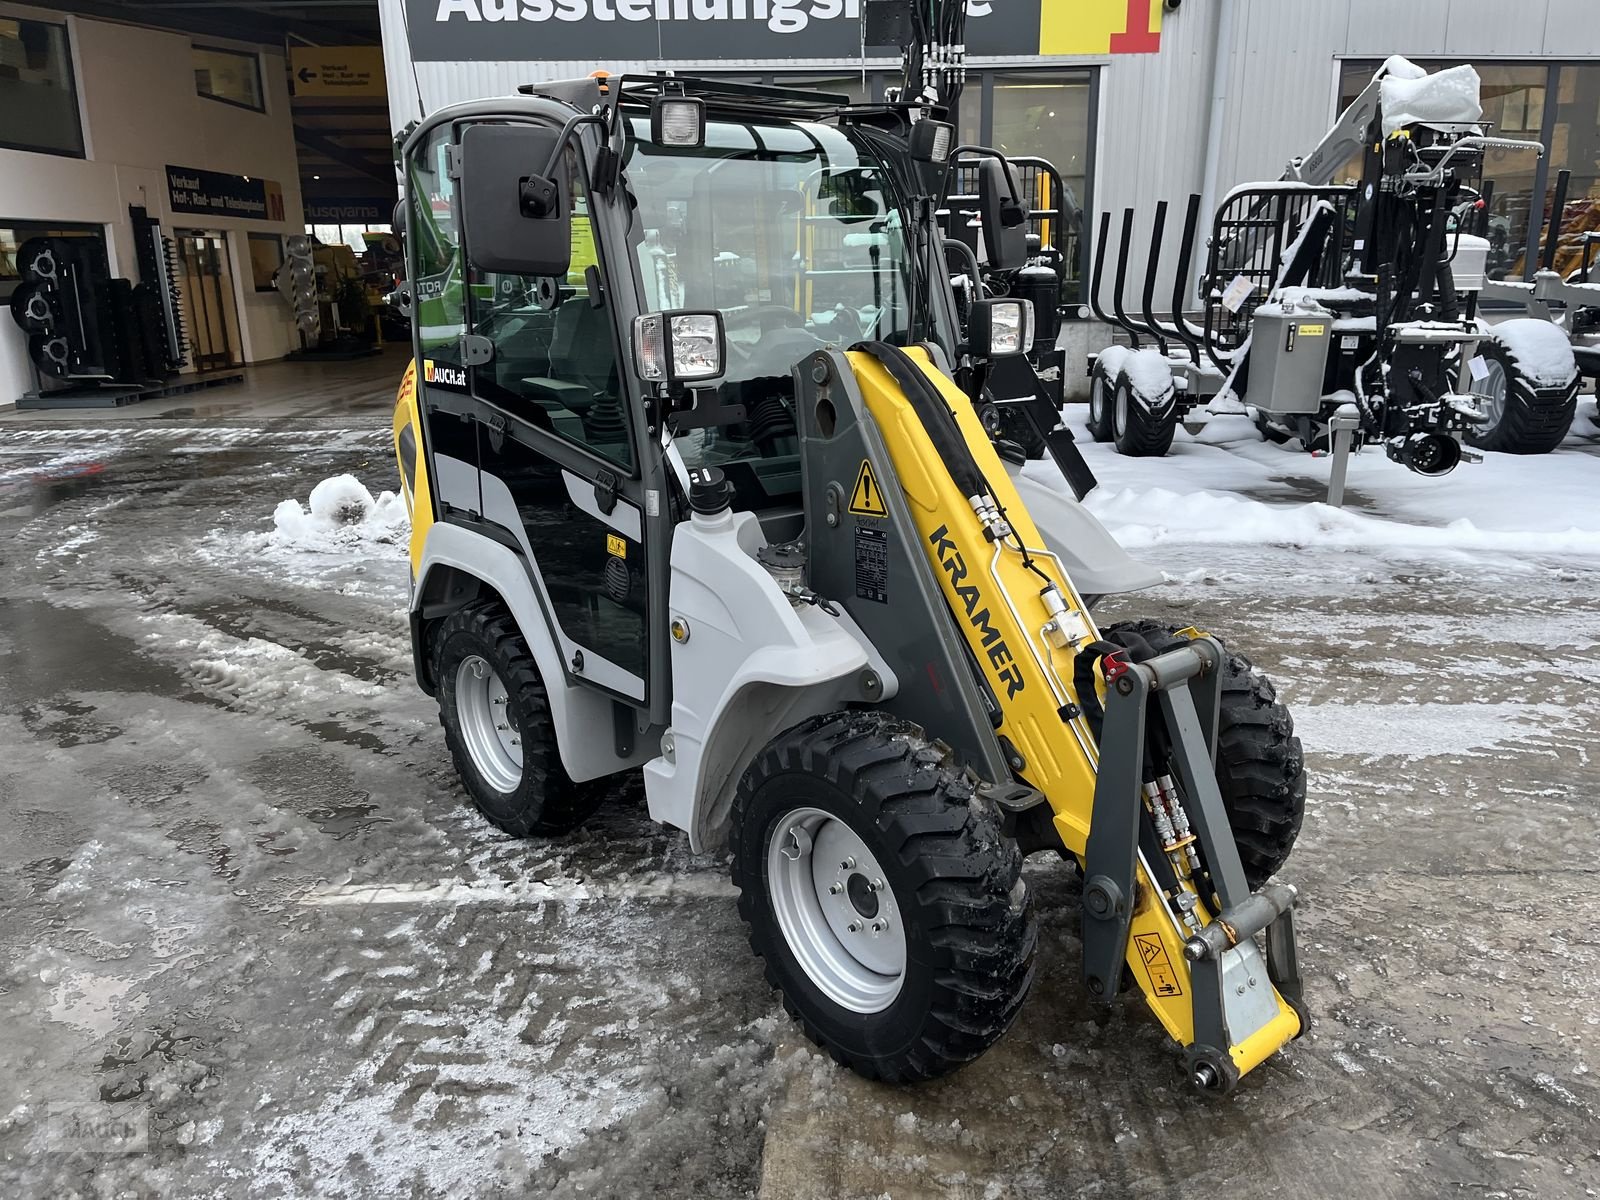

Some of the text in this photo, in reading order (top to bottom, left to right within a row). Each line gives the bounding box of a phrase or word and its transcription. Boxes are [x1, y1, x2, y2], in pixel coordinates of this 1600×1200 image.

[435, 0, 993, 33] Ausstellungs
[170, 174, 199, 190] Verkauf
[192, 192, 210, 206] Rad-
[210, 195, 224, 208] und
[427, 367, 466, 387] MAUCH.at
[928, 523, 1025, 702] KRAMER
